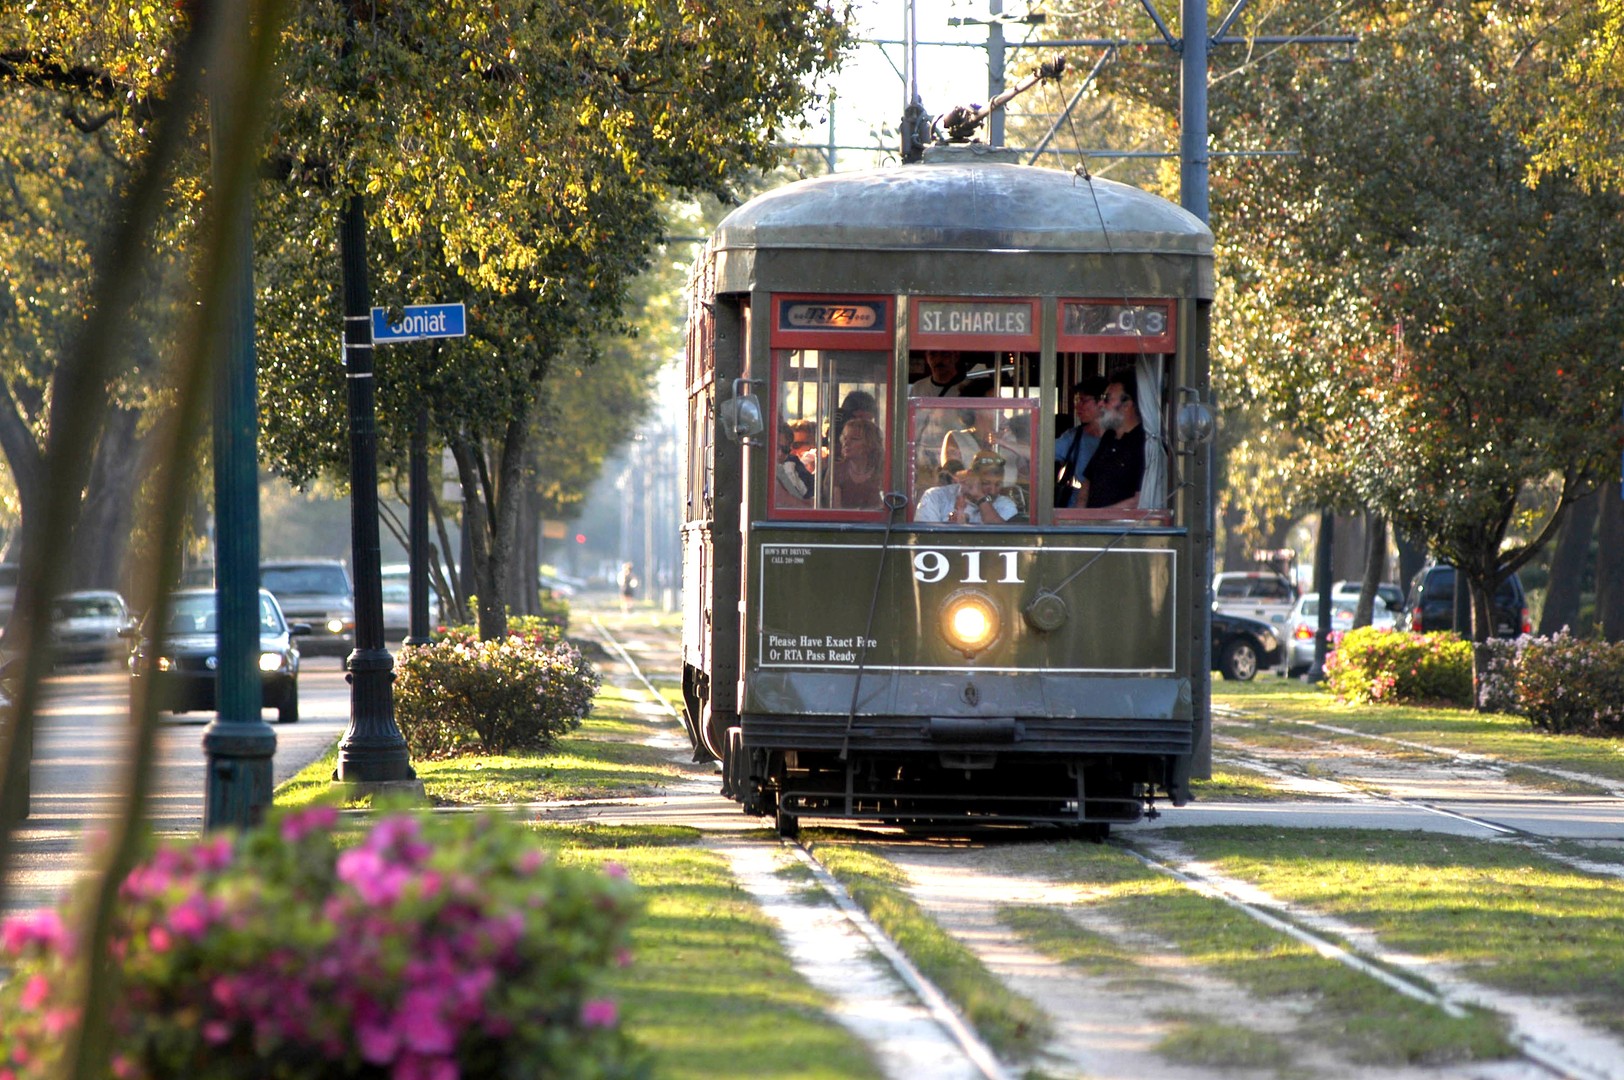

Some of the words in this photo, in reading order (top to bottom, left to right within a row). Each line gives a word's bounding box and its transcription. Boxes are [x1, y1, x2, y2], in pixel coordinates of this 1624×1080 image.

[805, 307, 857, 321] RTA
[923, 310, 945, 331] ST.
[950, 310, 1025, 333] CHARLES
[771, 556, 784, 564] CALL
[913, 550, 1025, 583] 911
[769, 635, 797, 647] Please
[800, 635, 822, 647] Have
[826, 635, 853, 647] Exact
[769, 649, 781, 660] Or
[784, 649, 803, 661] RTA
[806, 650, 826, 661] Pass
[829, 650, 857, 663] Ready
